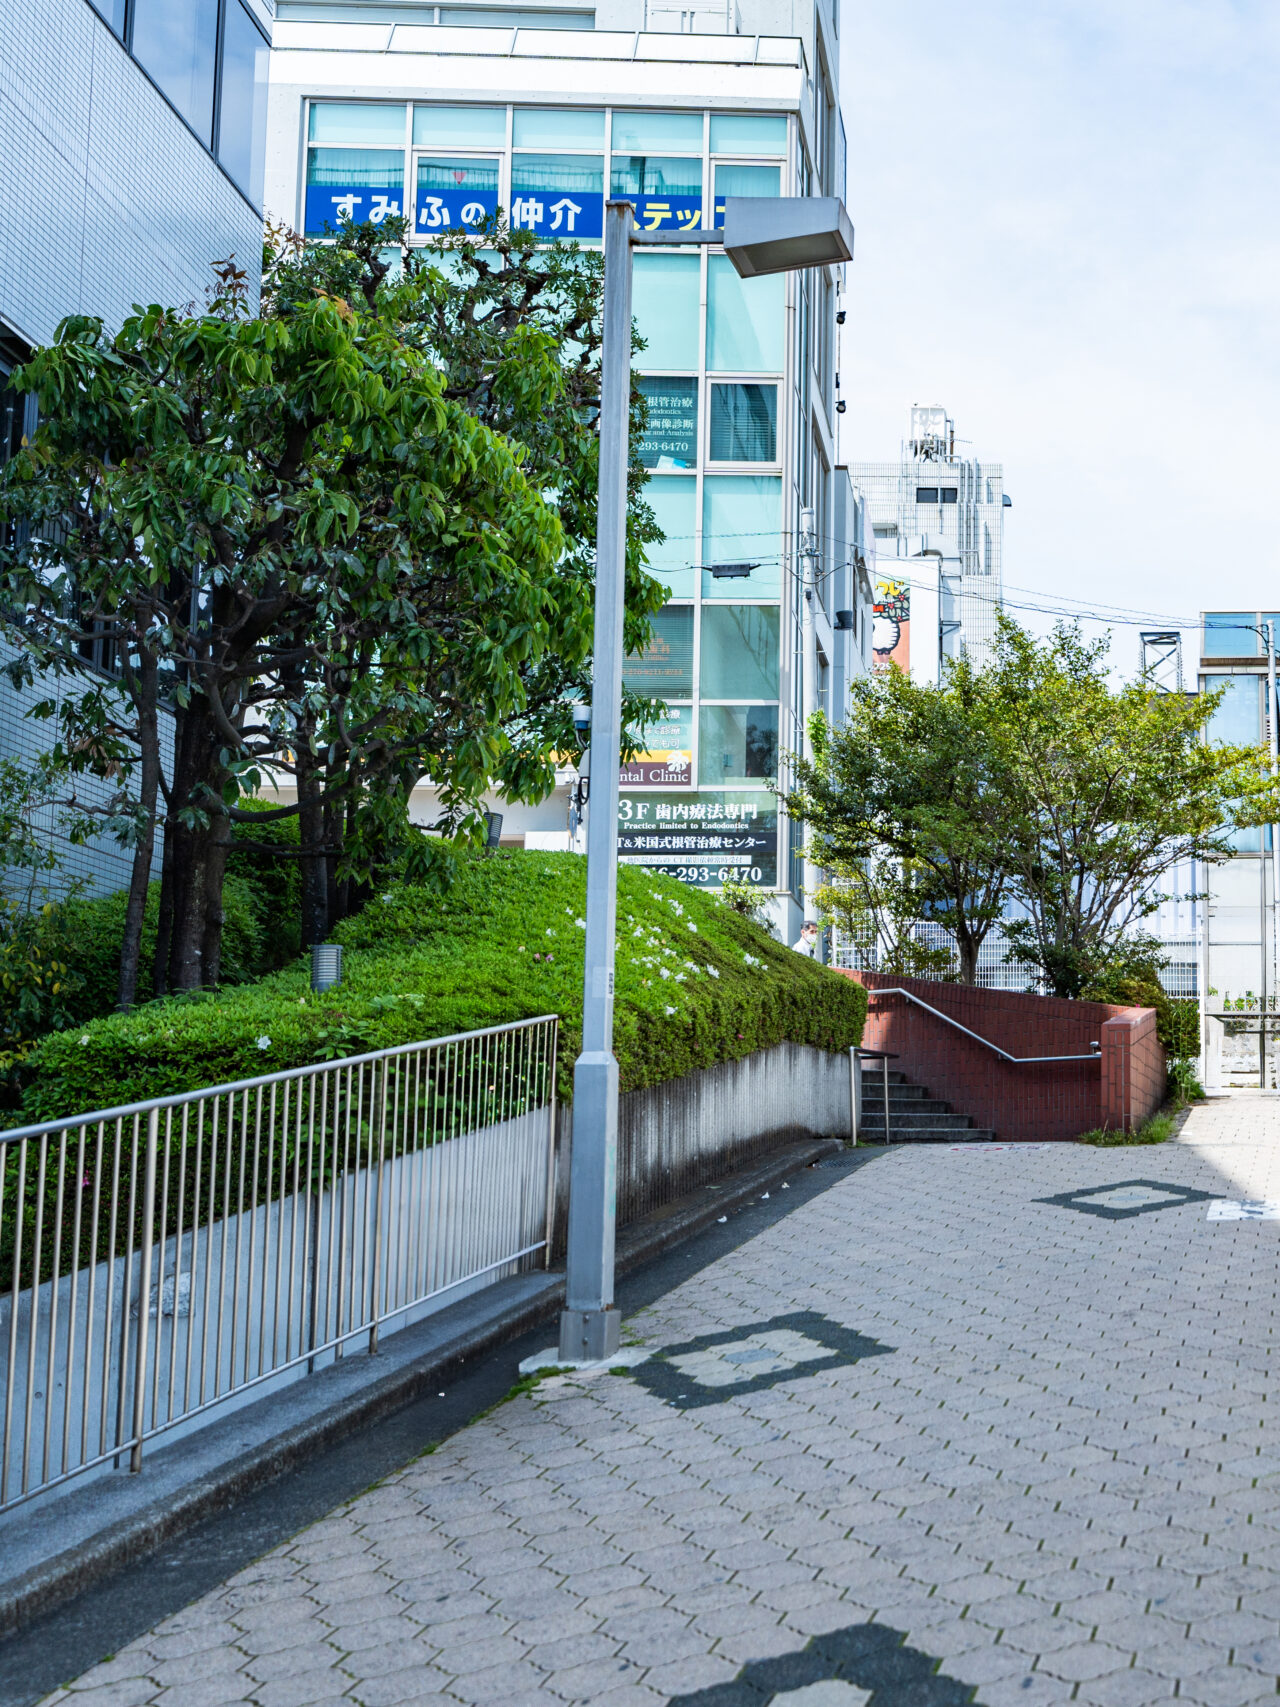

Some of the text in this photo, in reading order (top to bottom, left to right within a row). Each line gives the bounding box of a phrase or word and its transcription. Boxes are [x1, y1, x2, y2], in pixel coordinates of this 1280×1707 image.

[646, 396, 693, 408] 根管治療
[646, 418, 694, 430] 画像診断
[649, 769, 689, 782] Clinic
[617, 799, 758, 820] 3F 歯内療法専門
[623, 821, 749, 830] Practice limited to Endodontics
[653, 866, 763, 882] -293-6470
